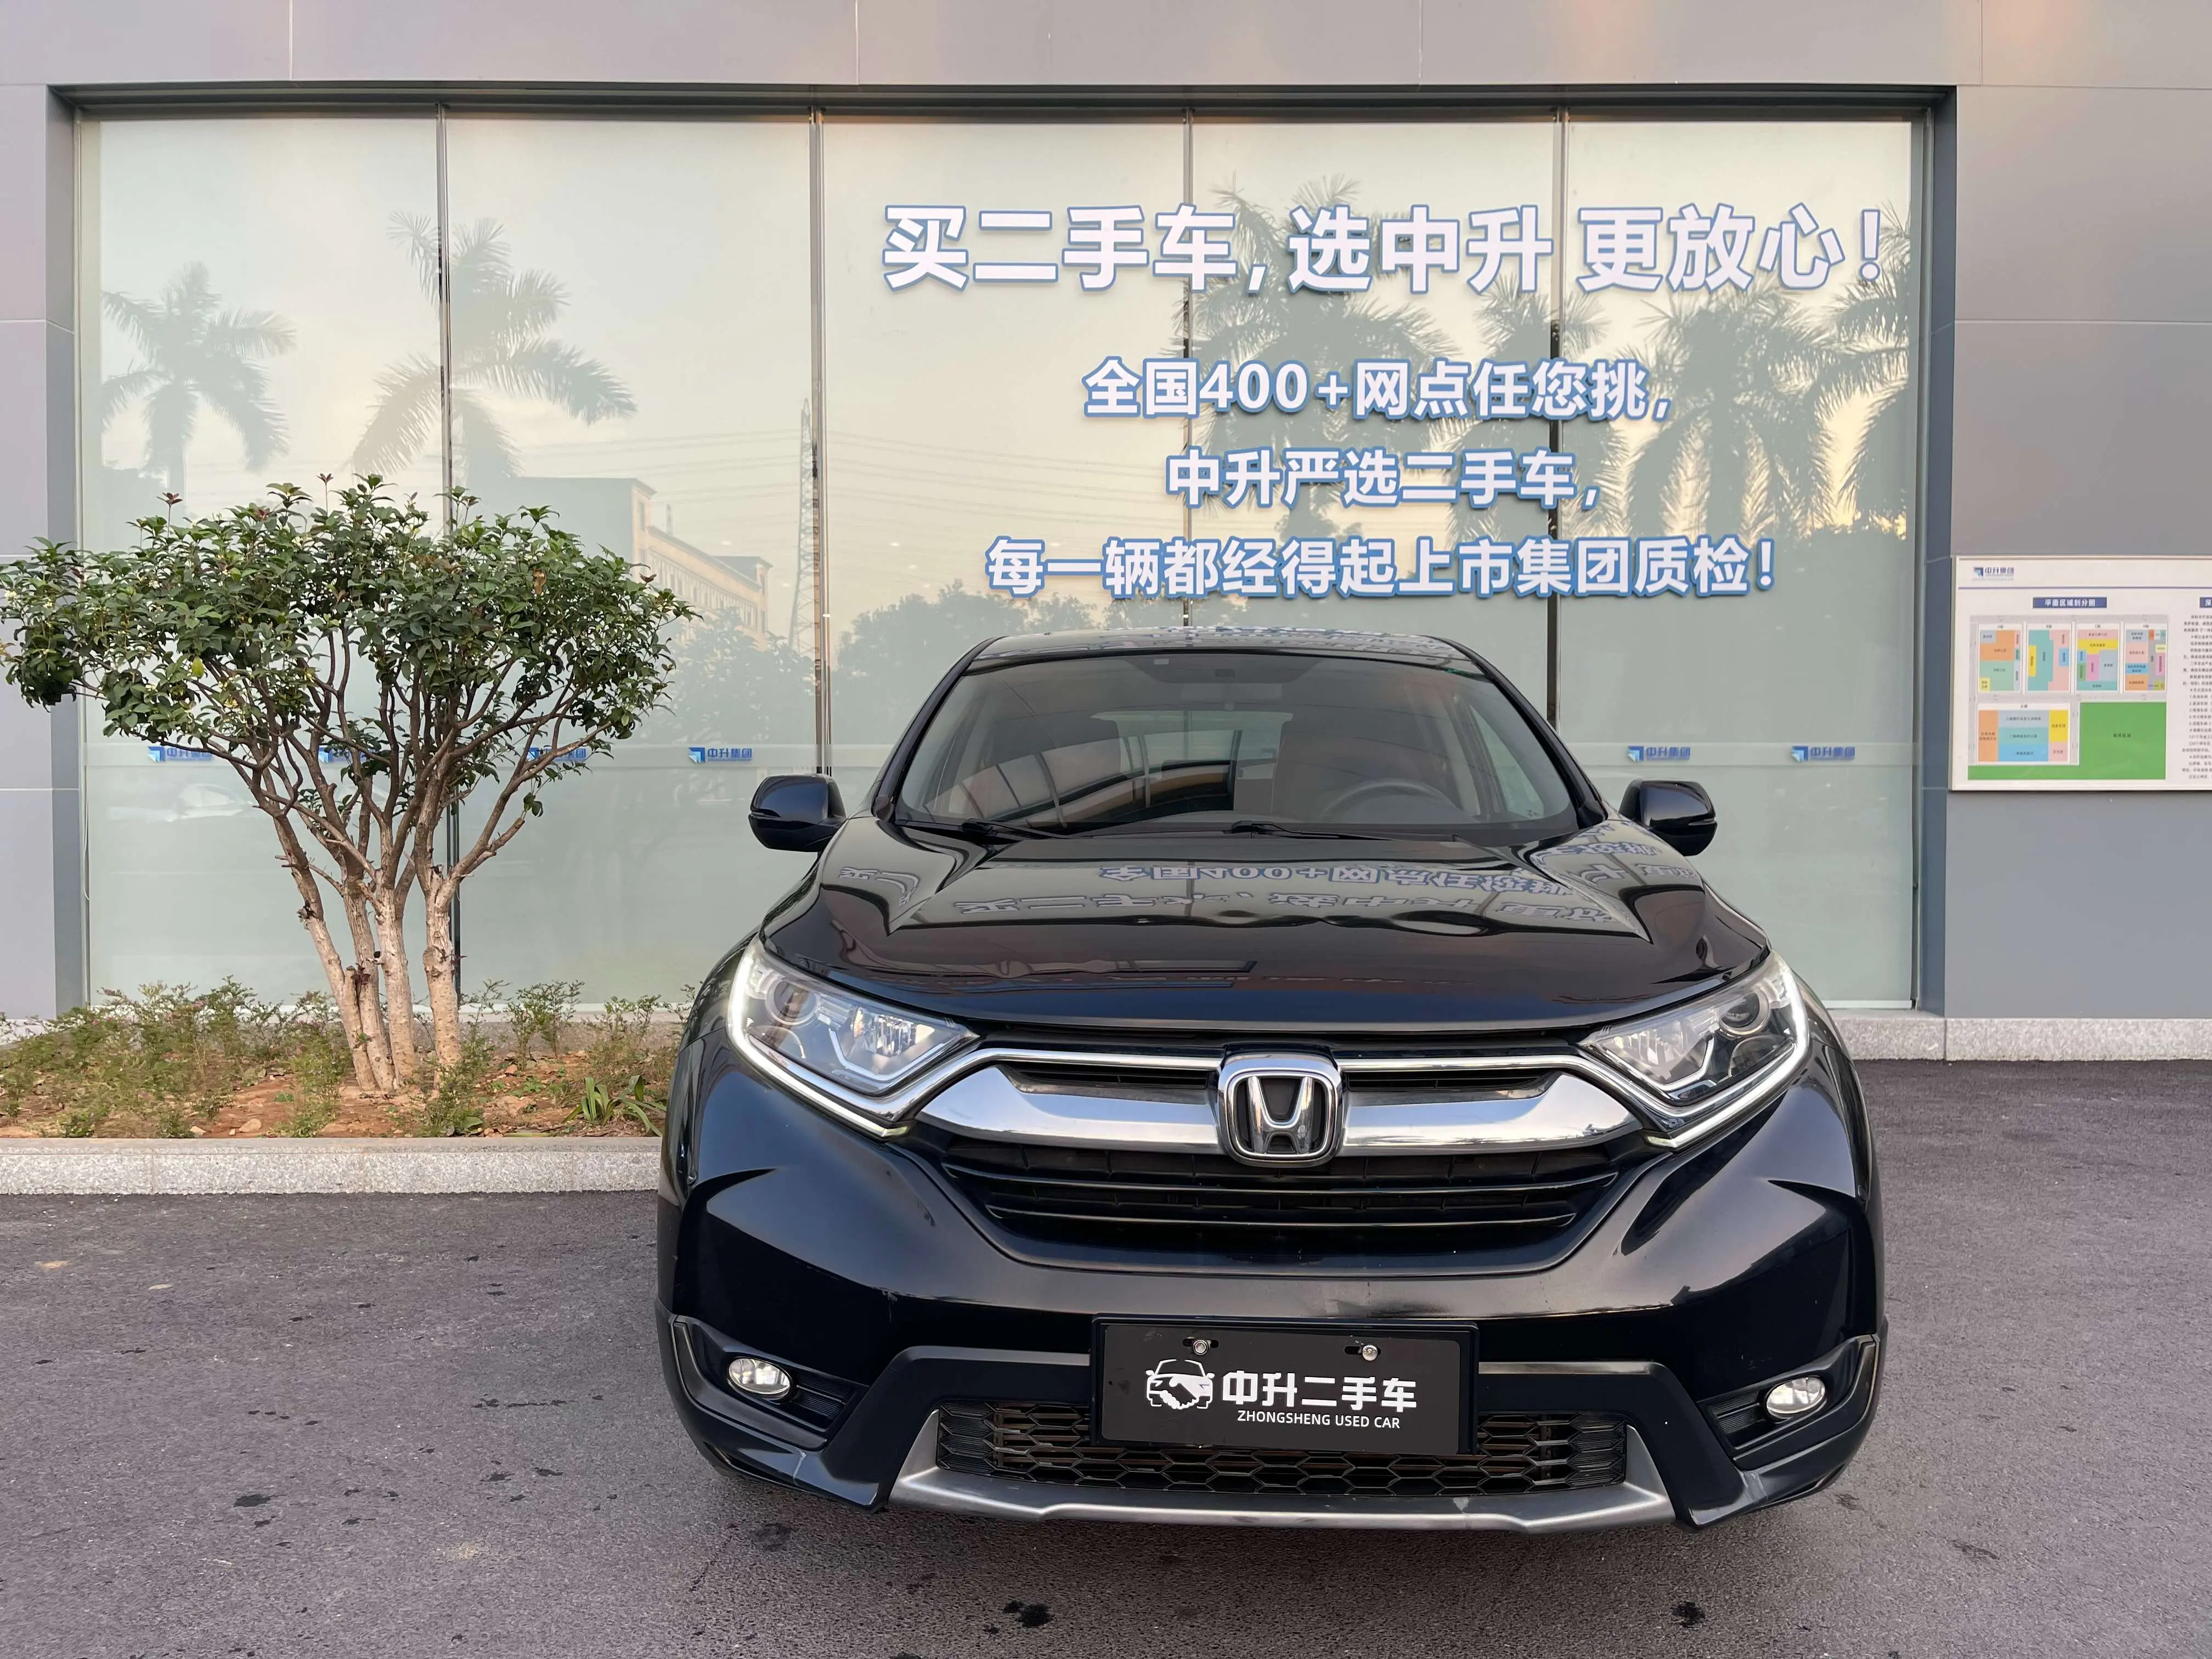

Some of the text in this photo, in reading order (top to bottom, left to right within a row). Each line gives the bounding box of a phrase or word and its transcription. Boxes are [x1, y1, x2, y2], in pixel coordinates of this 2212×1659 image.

[1166, 445, 1600, 510] 中升严选二手车，
[985, 534, 1775, 599] 每一辆都经得起上市集团质检！
[707, 748, 752, 758] 中升集团
[1222, 1369, 1417, 1413] 中升二手车
[1237, 1409, 1401, 1429] ZHONGSHENG USED CAR
